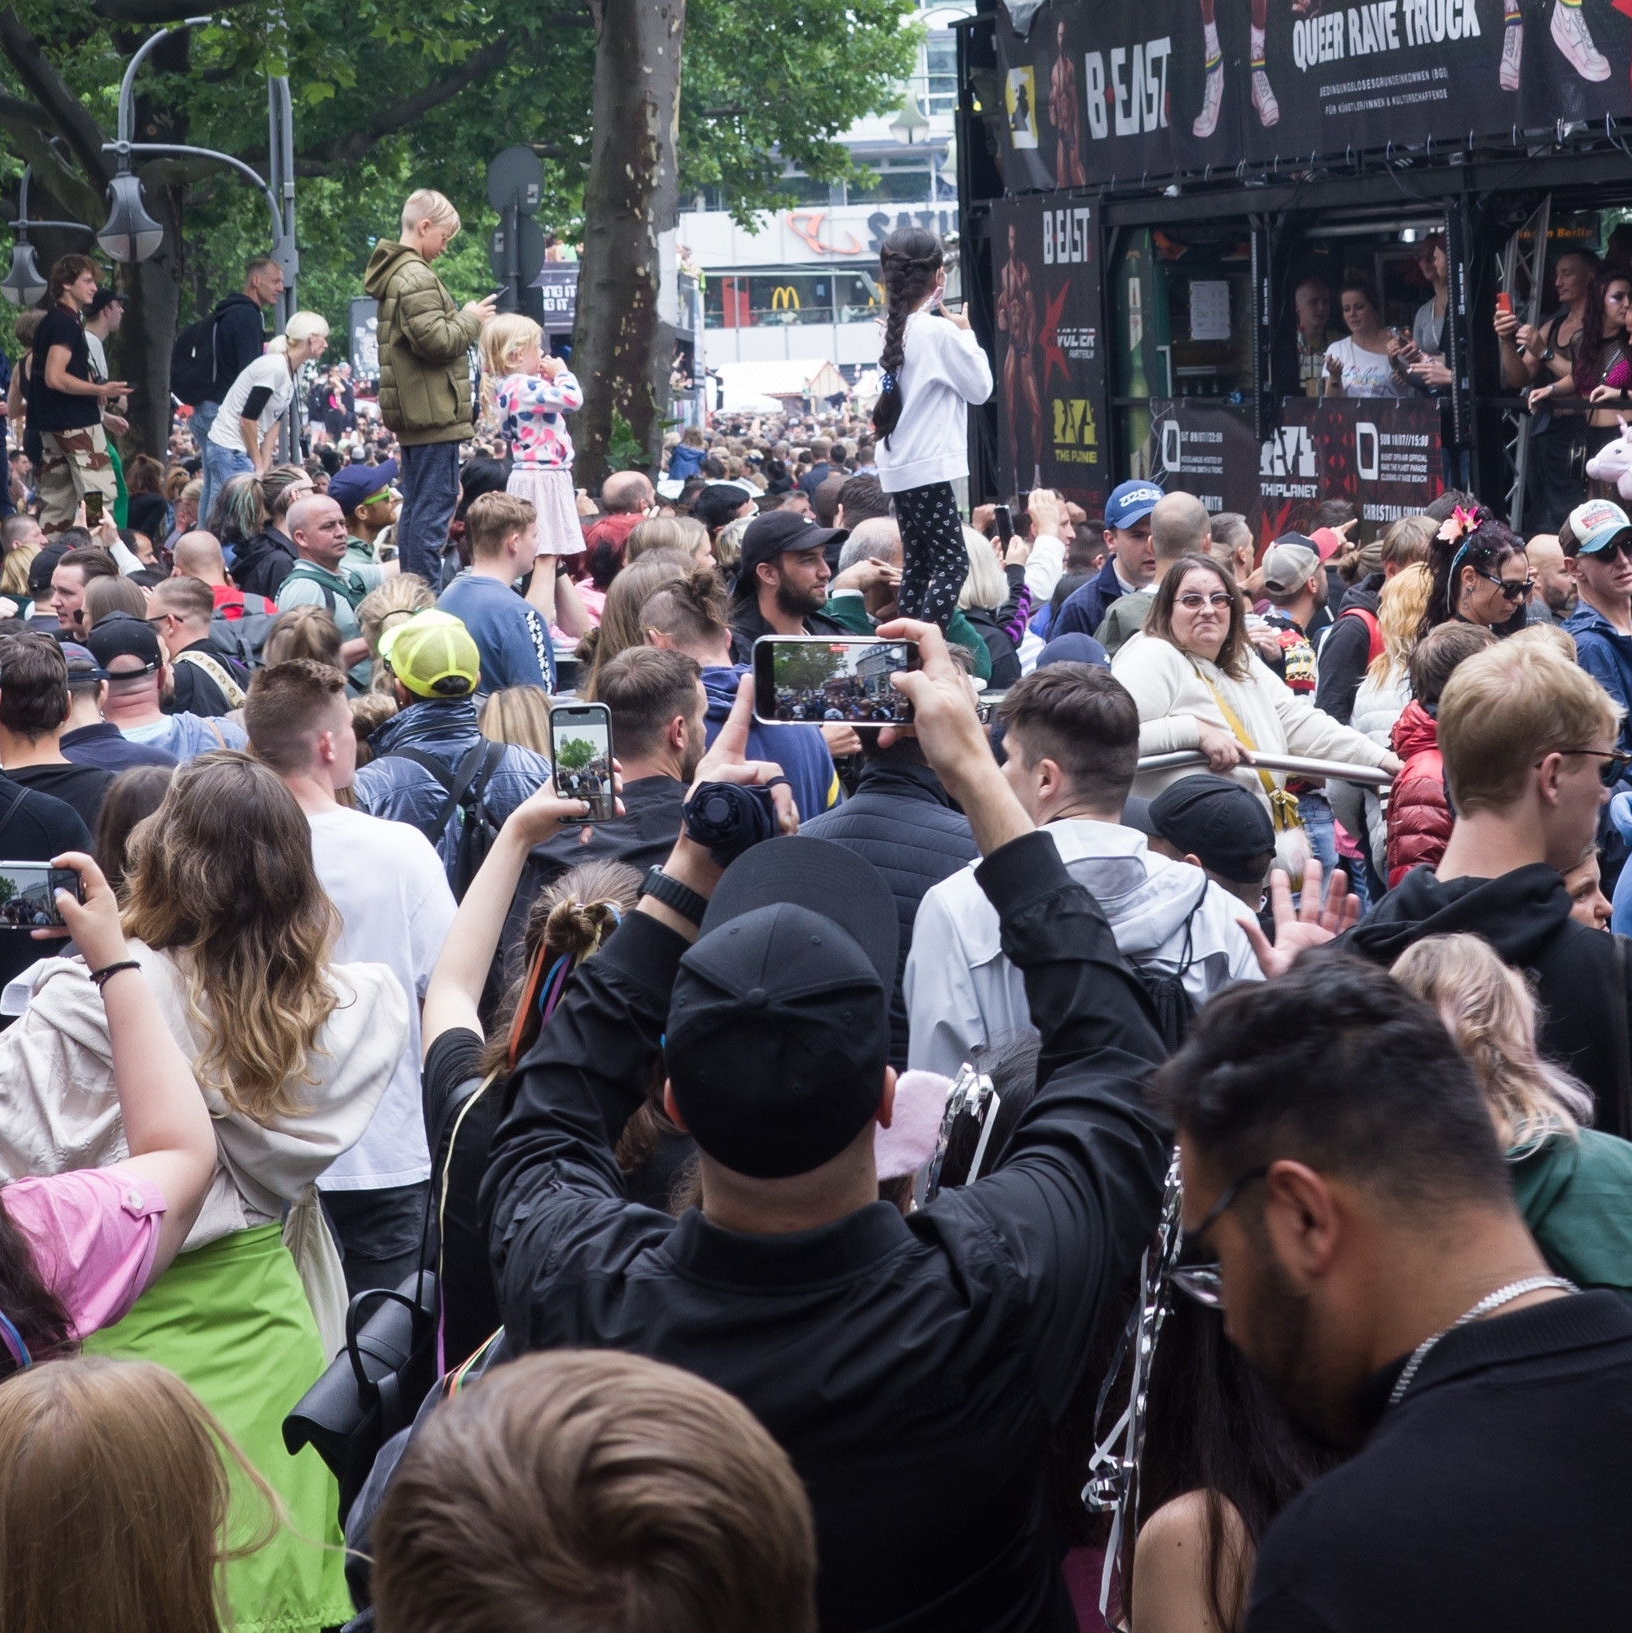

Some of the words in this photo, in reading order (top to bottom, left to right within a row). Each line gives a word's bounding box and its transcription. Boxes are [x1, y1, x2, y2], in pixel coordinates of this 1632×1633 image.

[1292, 10, 1345, 74] QUEER
[1347, 0, 1400, 57] RAVE
[1363, 503, 1402, 522] CHRISTIAN
